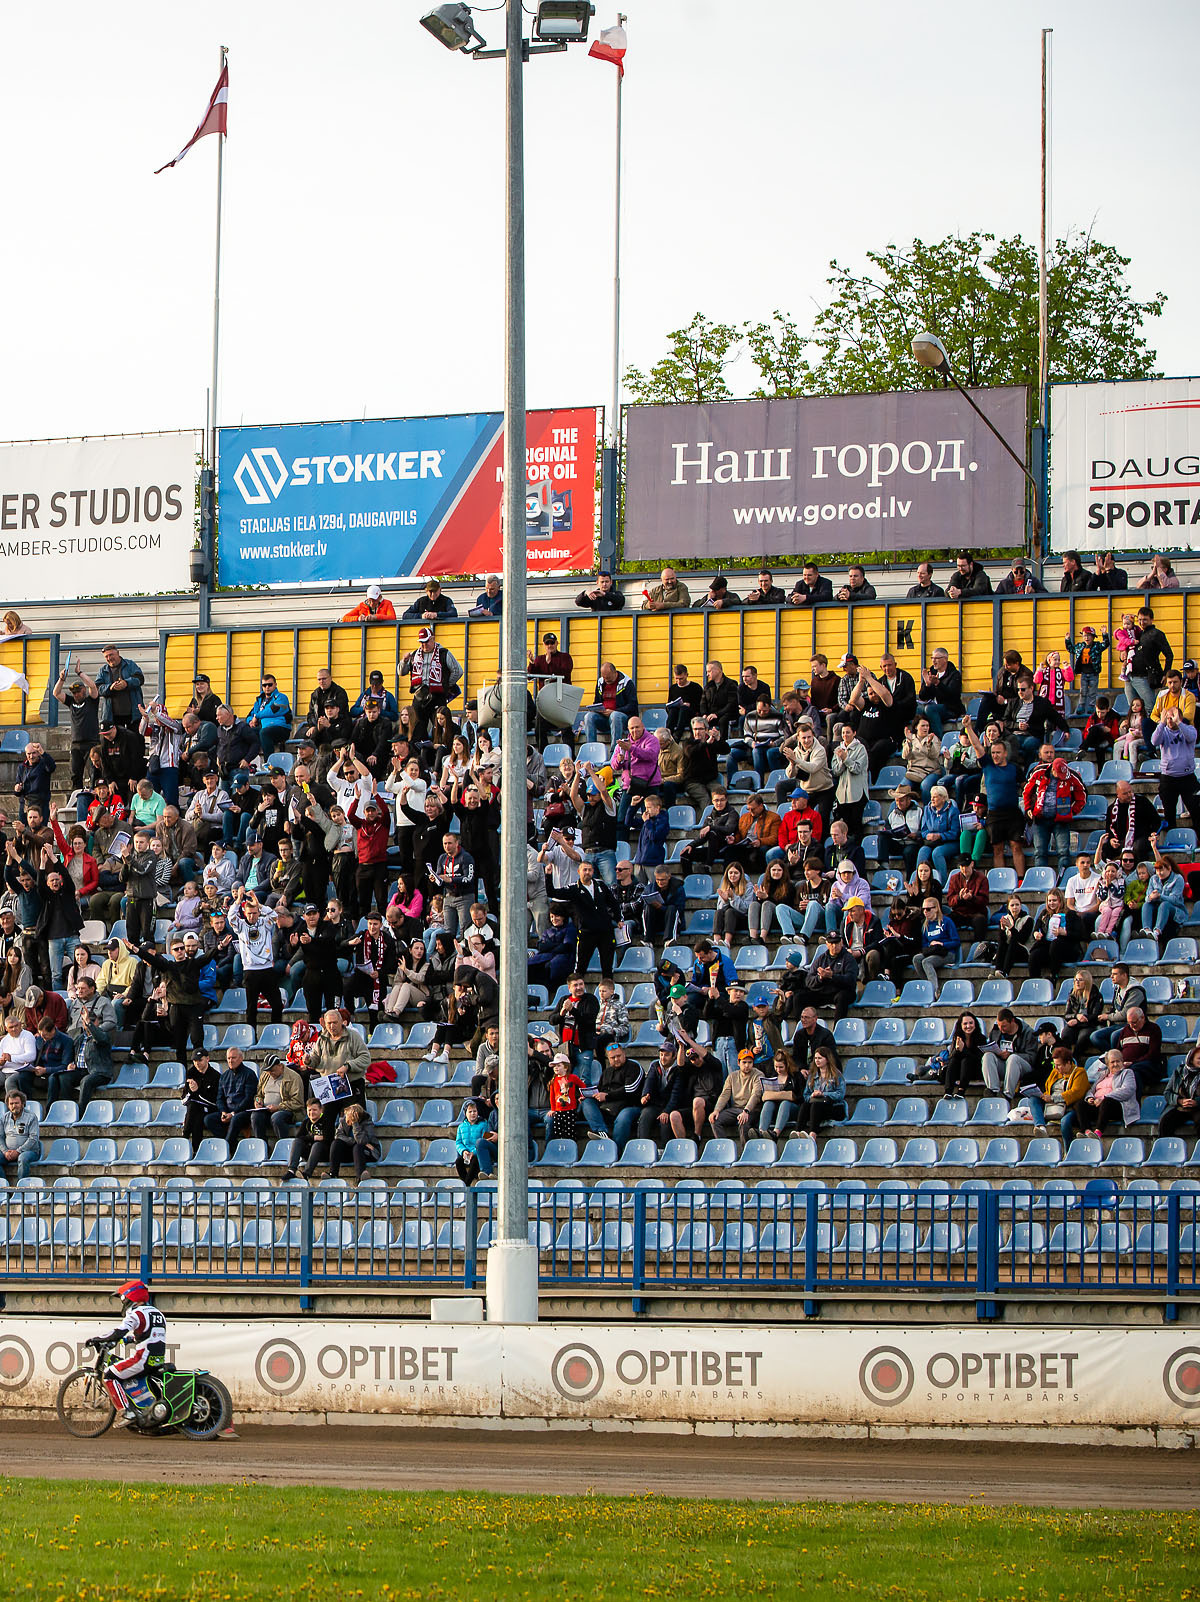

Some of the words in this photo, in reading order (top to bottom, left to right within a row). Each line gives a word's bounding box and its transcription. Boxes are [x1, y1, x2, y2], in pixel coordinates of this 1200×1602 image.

[552, 428, 578, 444] THE
[526, 446, 577, 463] IGINAL
[670, 441, 792, 485] Наш
[811, 439, 979, 487] город.
[496, 464, 550, 482] MOR
[553, 464, 577, 480] OIL
[49, 484, 182, 528] STUDIOS
[733, 496, 913, 526] www.gorod.lv
[240, 516, 291, 534] STACIJAS
[294, 515, 316, 531] IELA
[319, 513, 346, 532] 129d,
[349, 510, 417, 528] DAUGAVPILS
[239, 540, 327, 560] www.stokker.lv
[897, 620, 914, 650] K
[535, 1025, 545, 1033] 20
[846, 1022, 857, 1031] 28
[885, 1022, 898, 1031] 29
[152, 1315, 163, 1324] 13
[317, 1344, 458, 1381] OPTIBET
[616, 1350, 763, 1386] OPTIBET
[926, 1352, 1079, 1389] OPTIBET
[317, 1383, 394, 1393] SPORTA
[409, 1383, 459, 1394] BĀRS
[616, 1389, 697, 1399] SPORTA
[712, 1388, 763, 1400] BĀRS
[927, 1392, 1010, 1401] SPORTA
[1027, 1390, 1079, 1402] BĀRS
